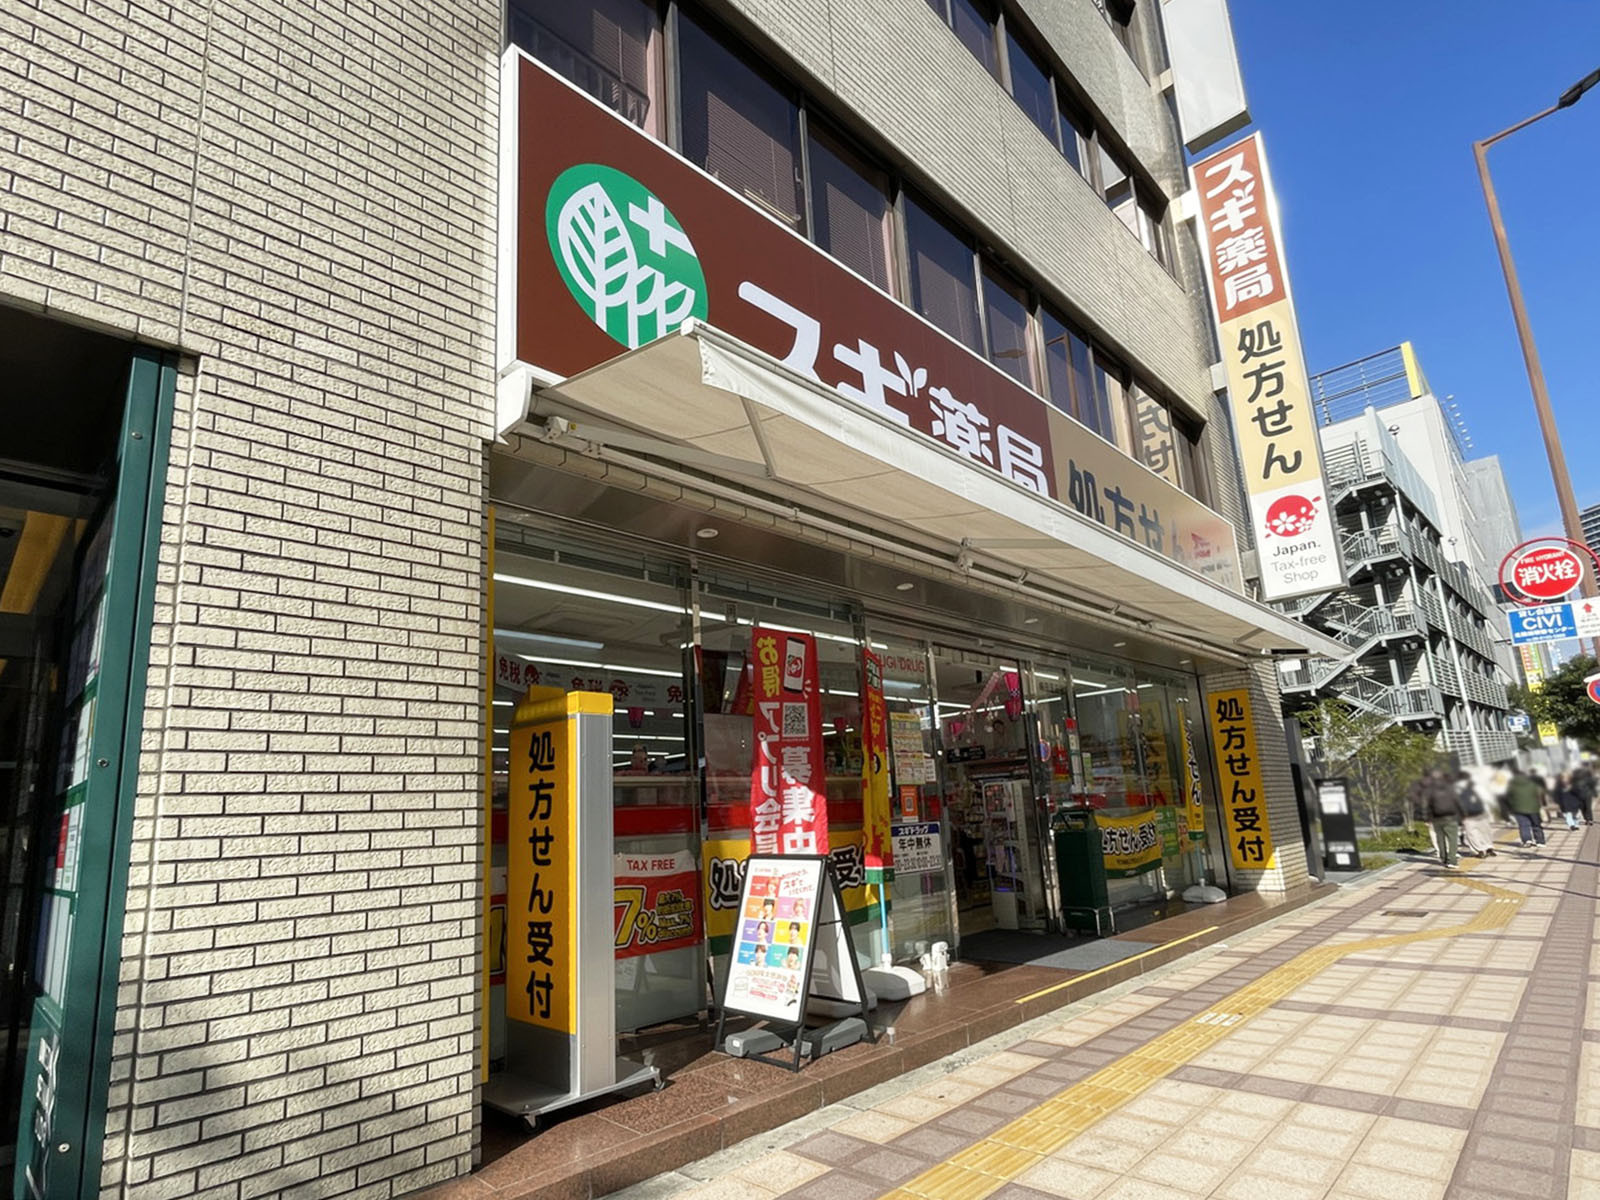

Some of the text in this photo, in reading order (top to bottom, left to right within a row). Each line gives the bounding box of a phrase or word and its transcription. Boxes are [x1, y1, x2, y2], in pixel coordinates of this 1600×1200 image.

[1205, 152, 1274, 311] スギ薬局
[1238, 320, 1302, 480] 処方せん
[1270, 553, 1327, 573] Tax-free
[1272, 541, 1321, 557] Japan.
[1283, 570, 1318, 584] Shop
[1517, 558, 1577, 587] 消火栓
[1522, 614, 1562, 630] CIVI
[1216, 698, 1265, 862] 処方せん受付
[1101, 821, 1156, 854] 方せん受付
[526, 731, 554, 1019] 処方せん受付
[626, 858, 676, 872] TAX FREE
